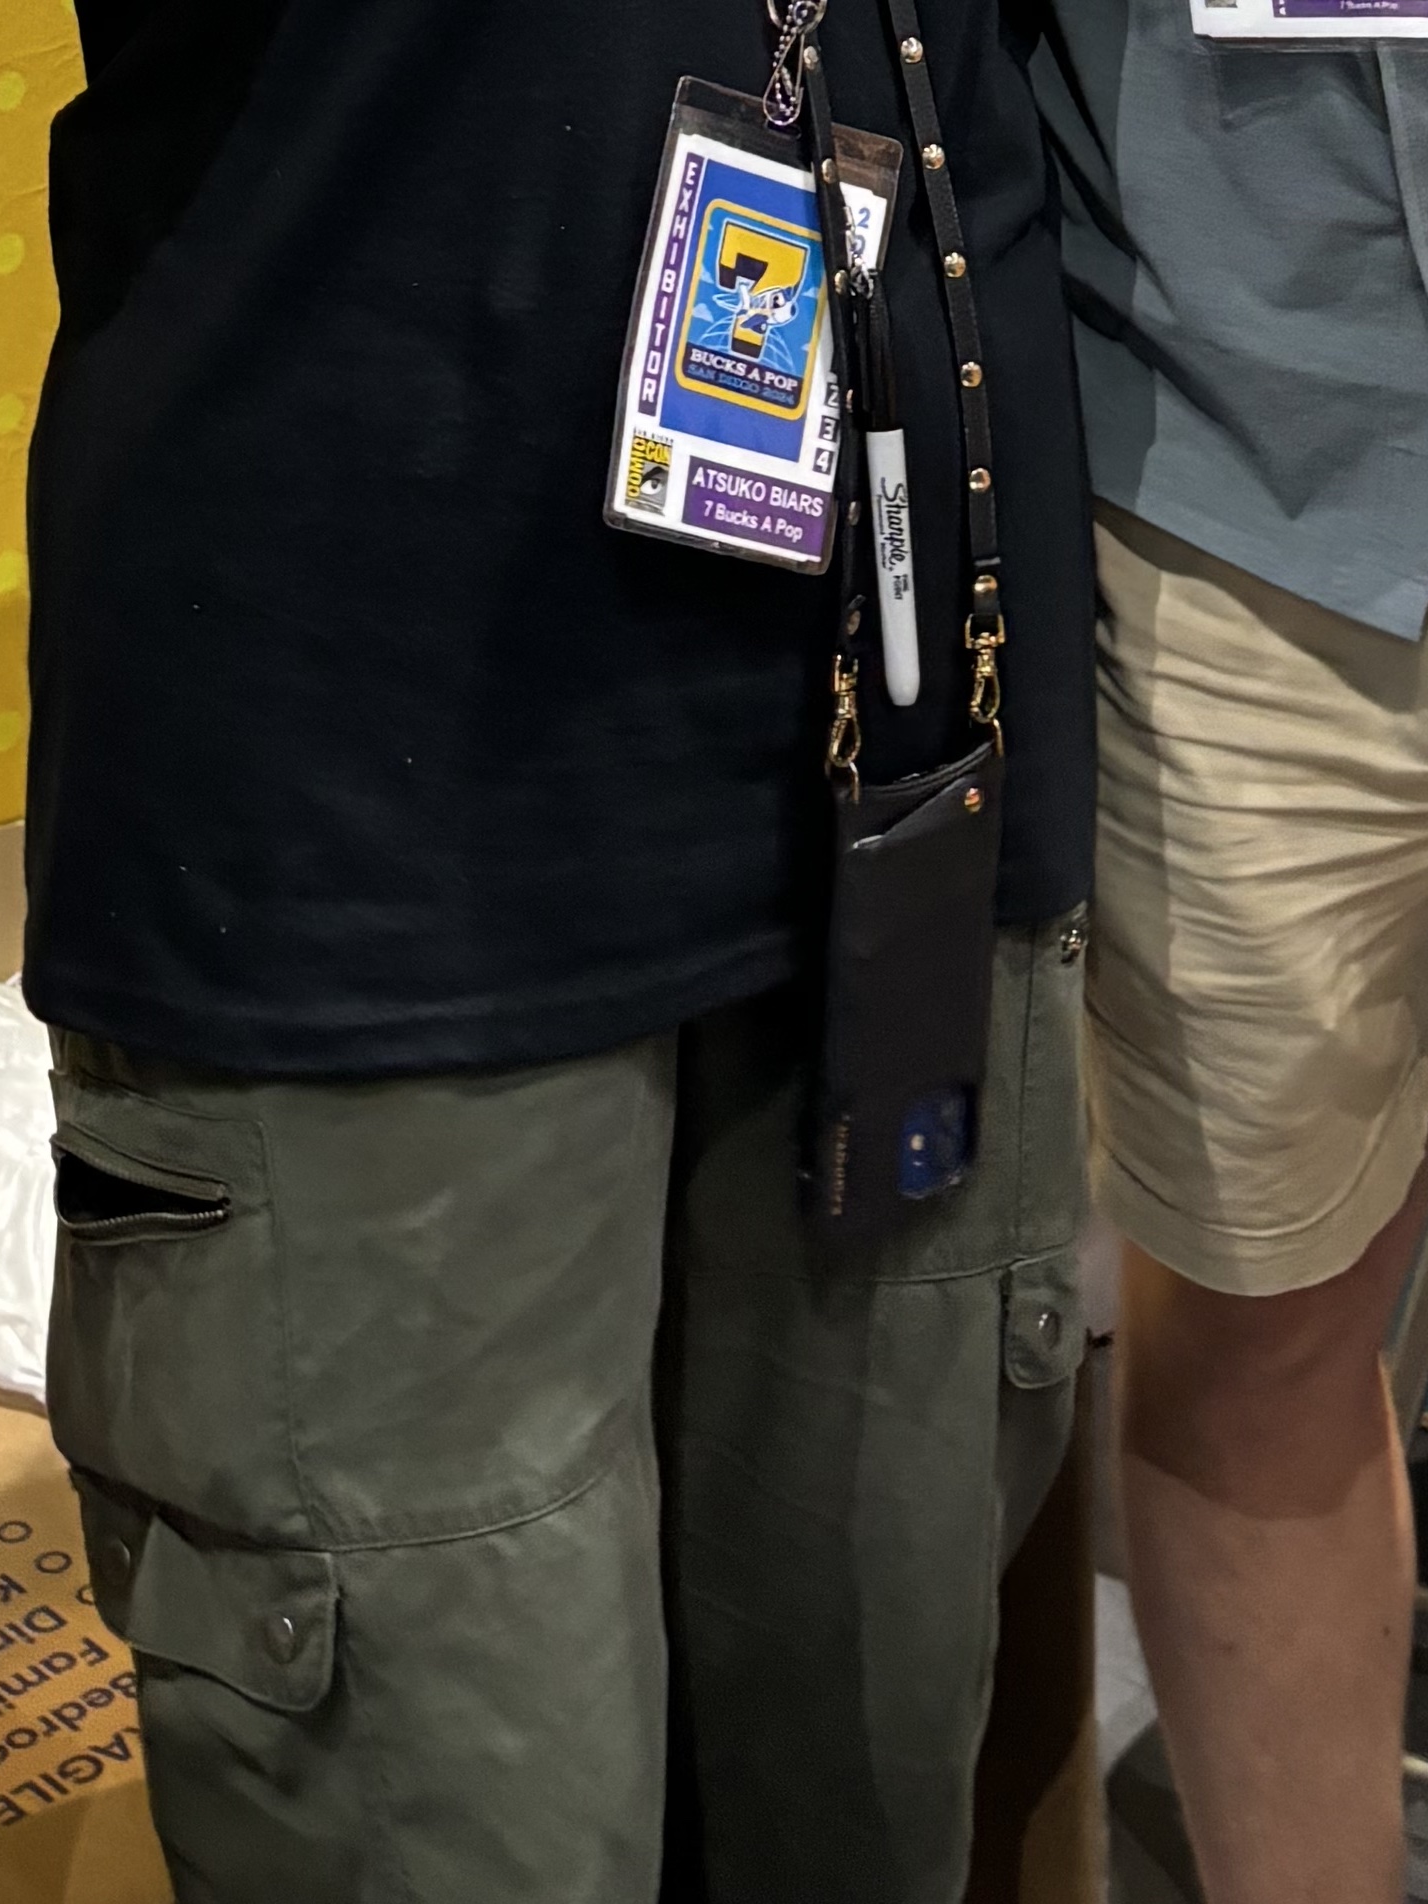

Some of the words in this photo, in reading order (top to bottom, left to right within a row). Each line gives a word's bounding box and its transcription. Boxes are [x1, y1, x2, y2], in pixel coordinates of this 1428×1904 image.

[641, 158, 700, 403] EXHIBITOR
[718, 219, 810, 358] 7
[689, 347, 746, 381] BUCKS
[747, 363, 763, 381] A
[764, 366, 799, 392] POP
[815, 451, 830, 472] 4
[692, 466, 766, 503] ATSUKO
[769, 488, 825, 518] BIARS
[704, 500, 714, 516] 7
[715, 504, 759, 529] Bucks
[760, 517, 773, 533] A
[774, 518, 804, 543] Pop
